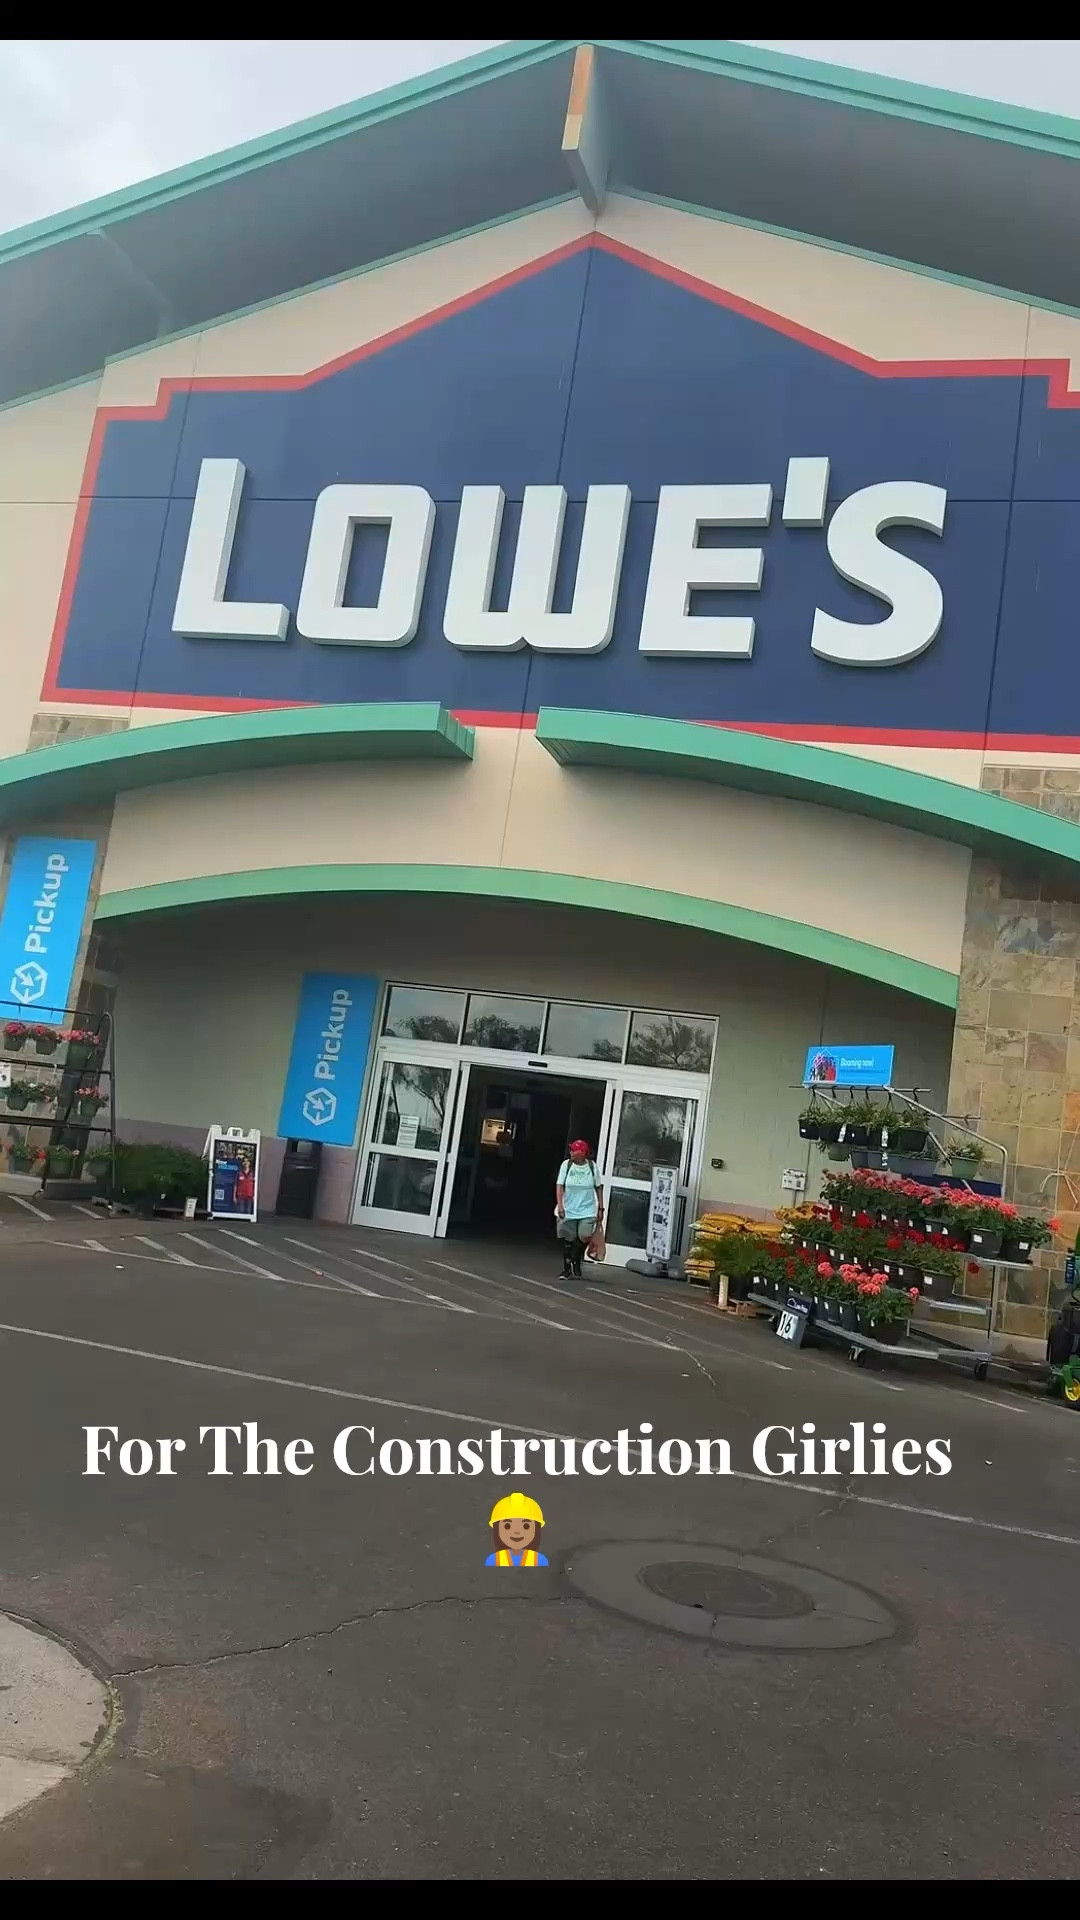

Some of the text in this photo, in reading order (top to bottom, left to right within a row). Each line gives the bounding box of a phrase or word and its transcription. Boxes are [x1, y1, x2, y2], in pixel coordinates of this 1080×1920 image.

[172, 456, 947, 667] LOWE'S
[24, 853, 69, 954] Pickup
[314, 988, 353, 1081] Pickup
